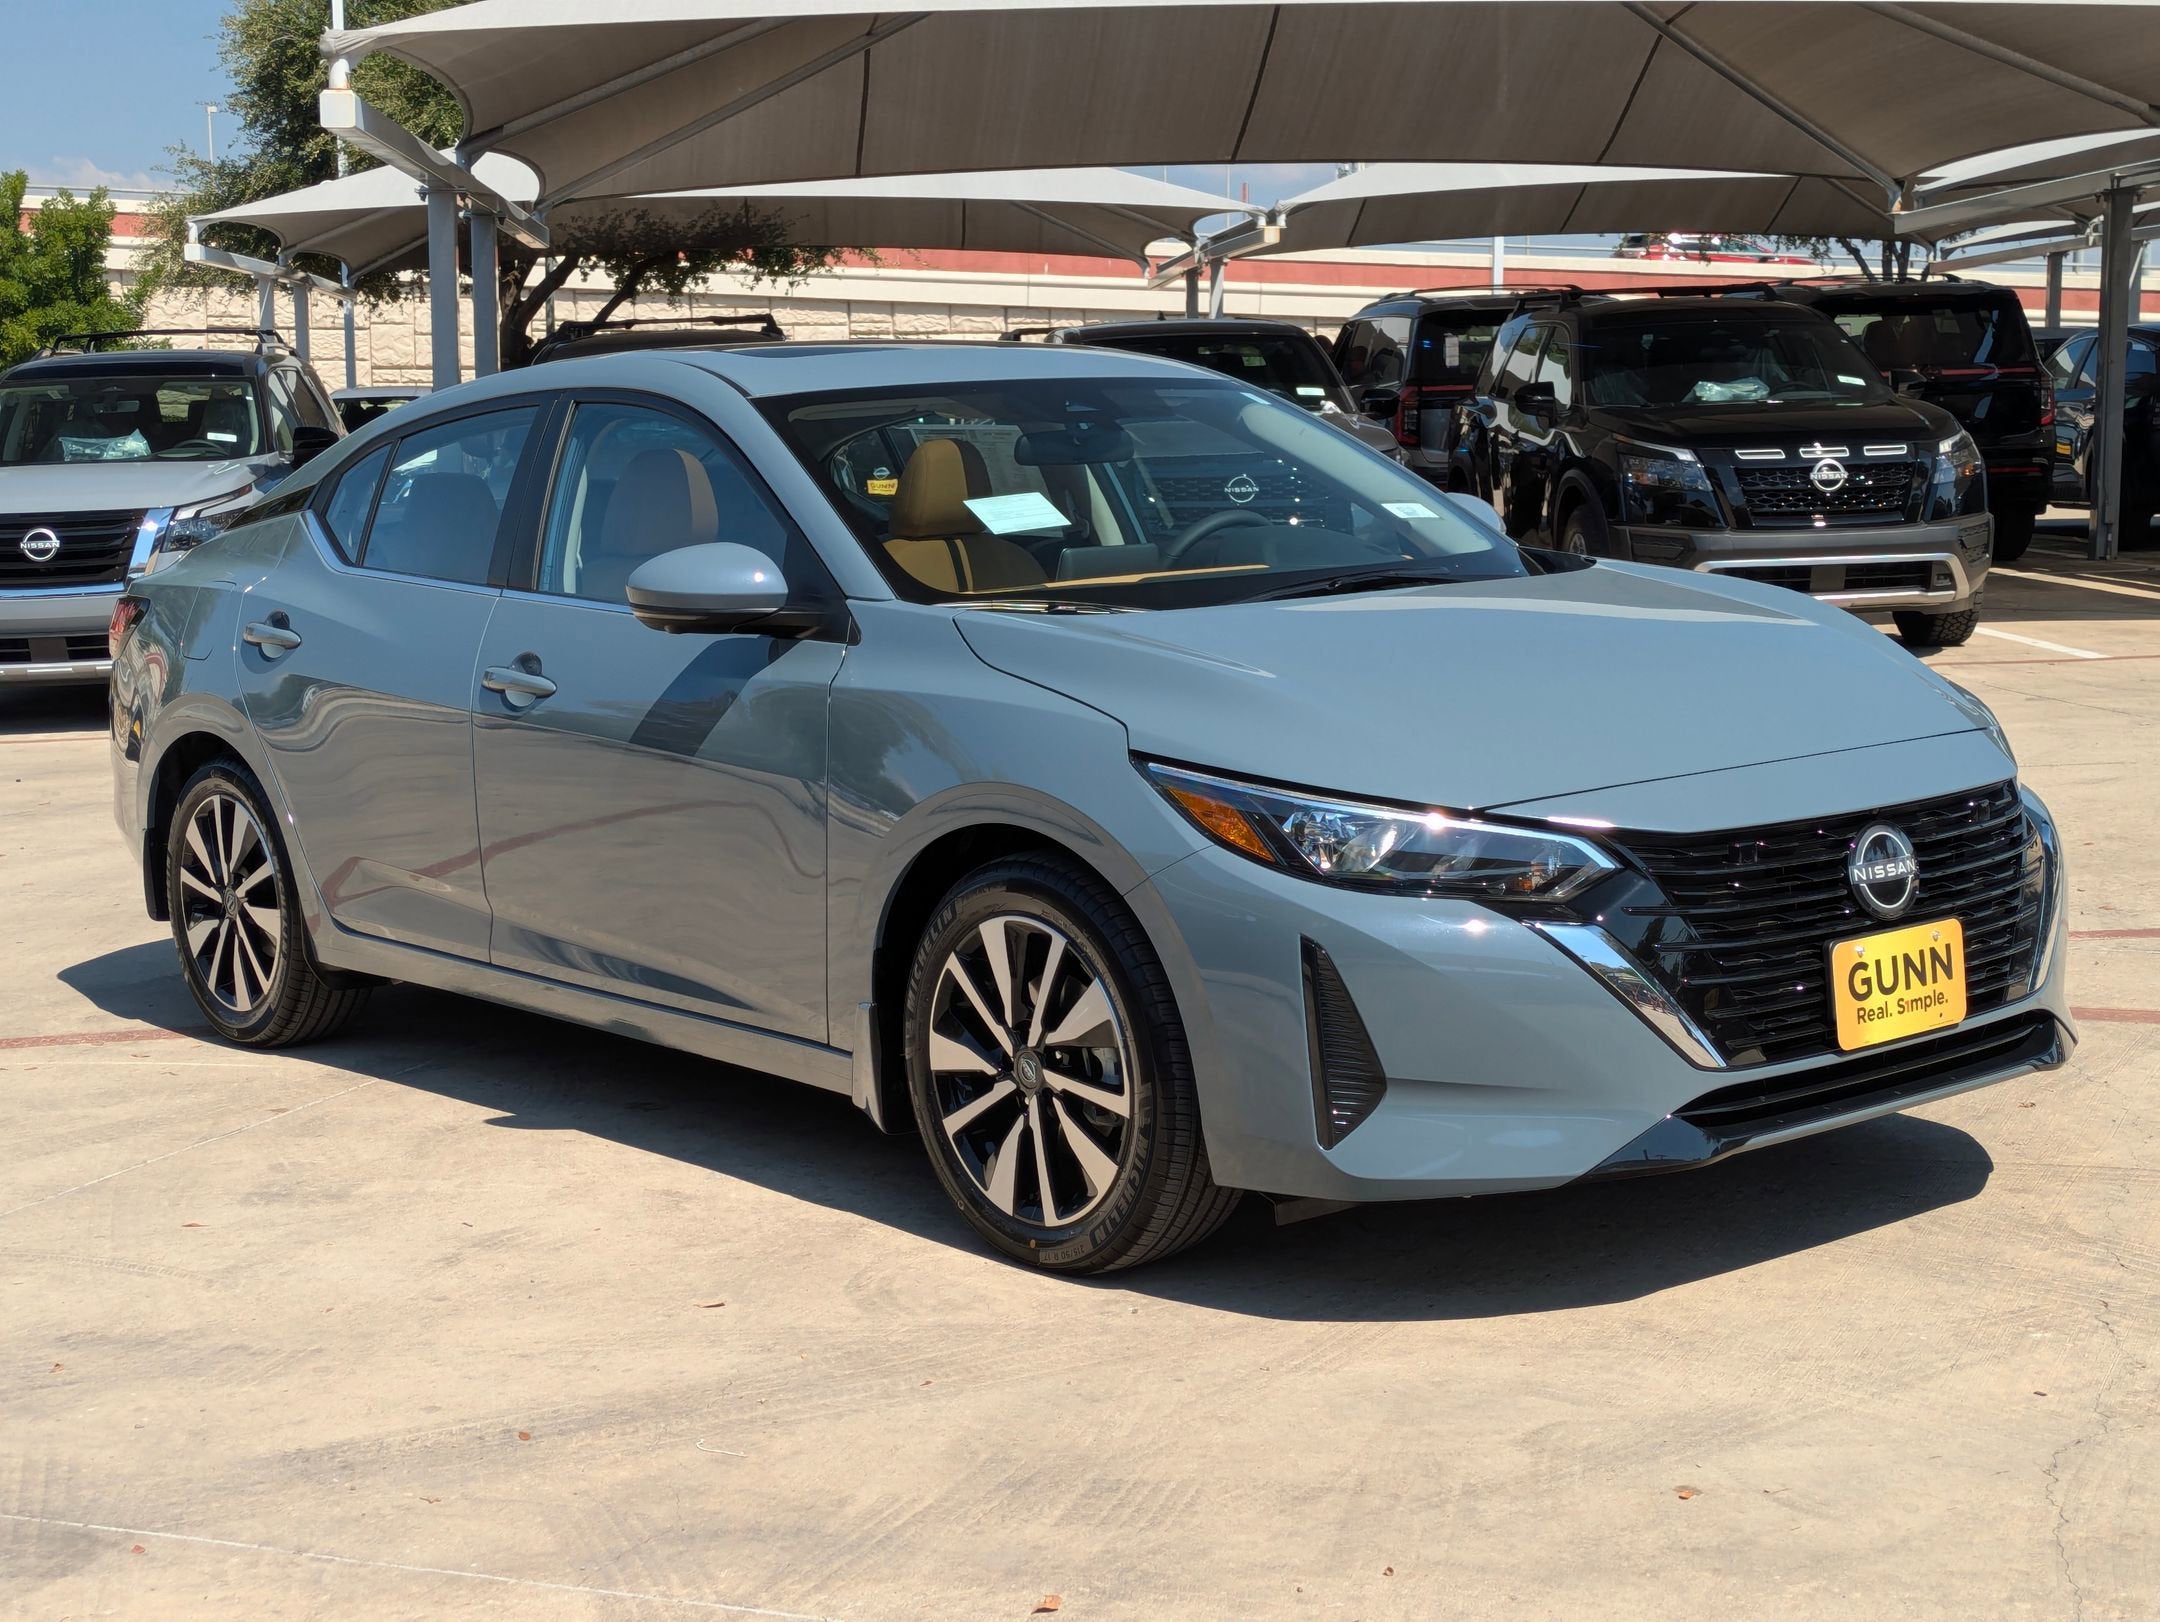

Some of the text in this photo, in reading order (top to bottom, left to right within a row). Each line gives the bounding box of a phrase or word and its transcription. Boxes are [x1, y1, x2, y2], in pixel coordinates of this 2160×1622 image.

[1810, 471, 1849, 480] NISSAN
[20, 540, 60, 549] NISSAN
[1853, 858, 1916, 881] NISSAN
[906, 903, 955, 1015] MICHELIN
[1848, 942, 1954, 1002] GUNN
[1857, 1001, 1893, 1025] Real.
[1094, 1133, 1150, 1246] MICHELIN
